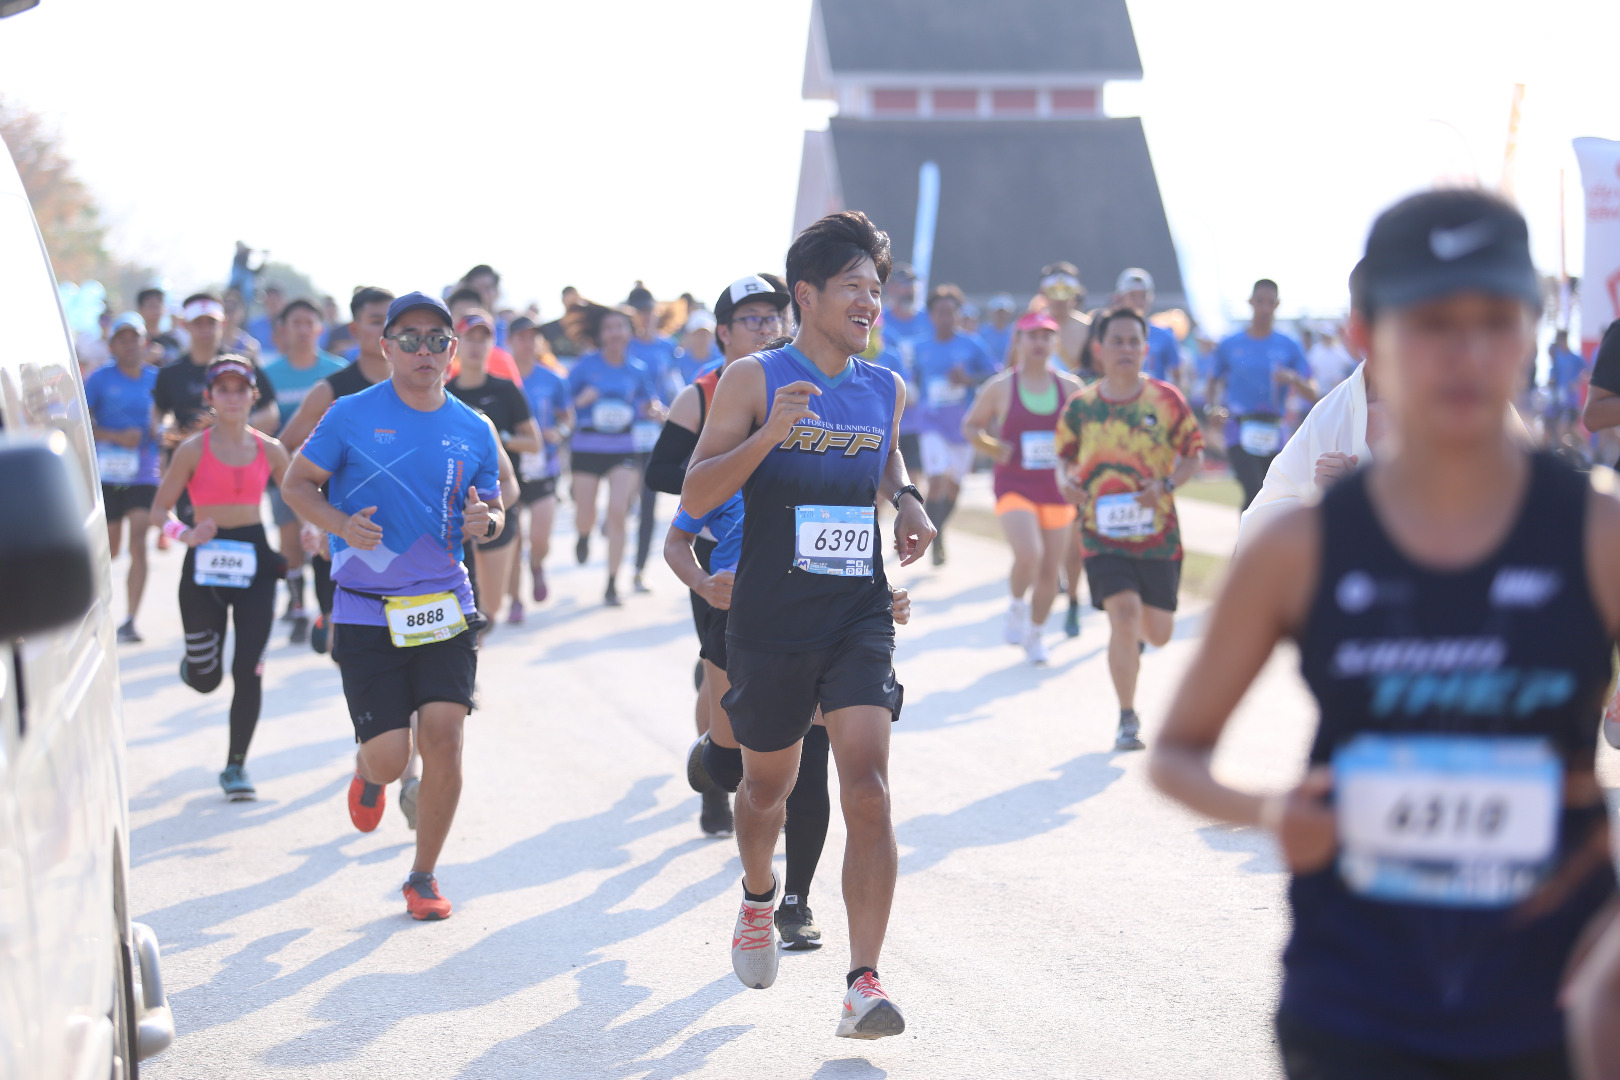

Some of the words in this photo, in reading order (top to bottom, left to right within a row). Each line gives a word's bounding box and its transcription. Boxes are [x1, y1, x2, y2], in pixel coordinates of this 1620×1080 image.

[807, 418, 822, 427] FOR
[822, 421, 834, 430] FUN
[836, 423, 871, 433] RUNNING
[872, 426, 885, 435] TEAM
[779, 425, 882, 456] RFF
[446, 458, 454, 485] CROSS
[814, 528, 870, 552] 6390
[210, 555, 243, 569] 6304
[406, 607, 444, 627] 8888
[1370, 668, 1575, 717] THEP
